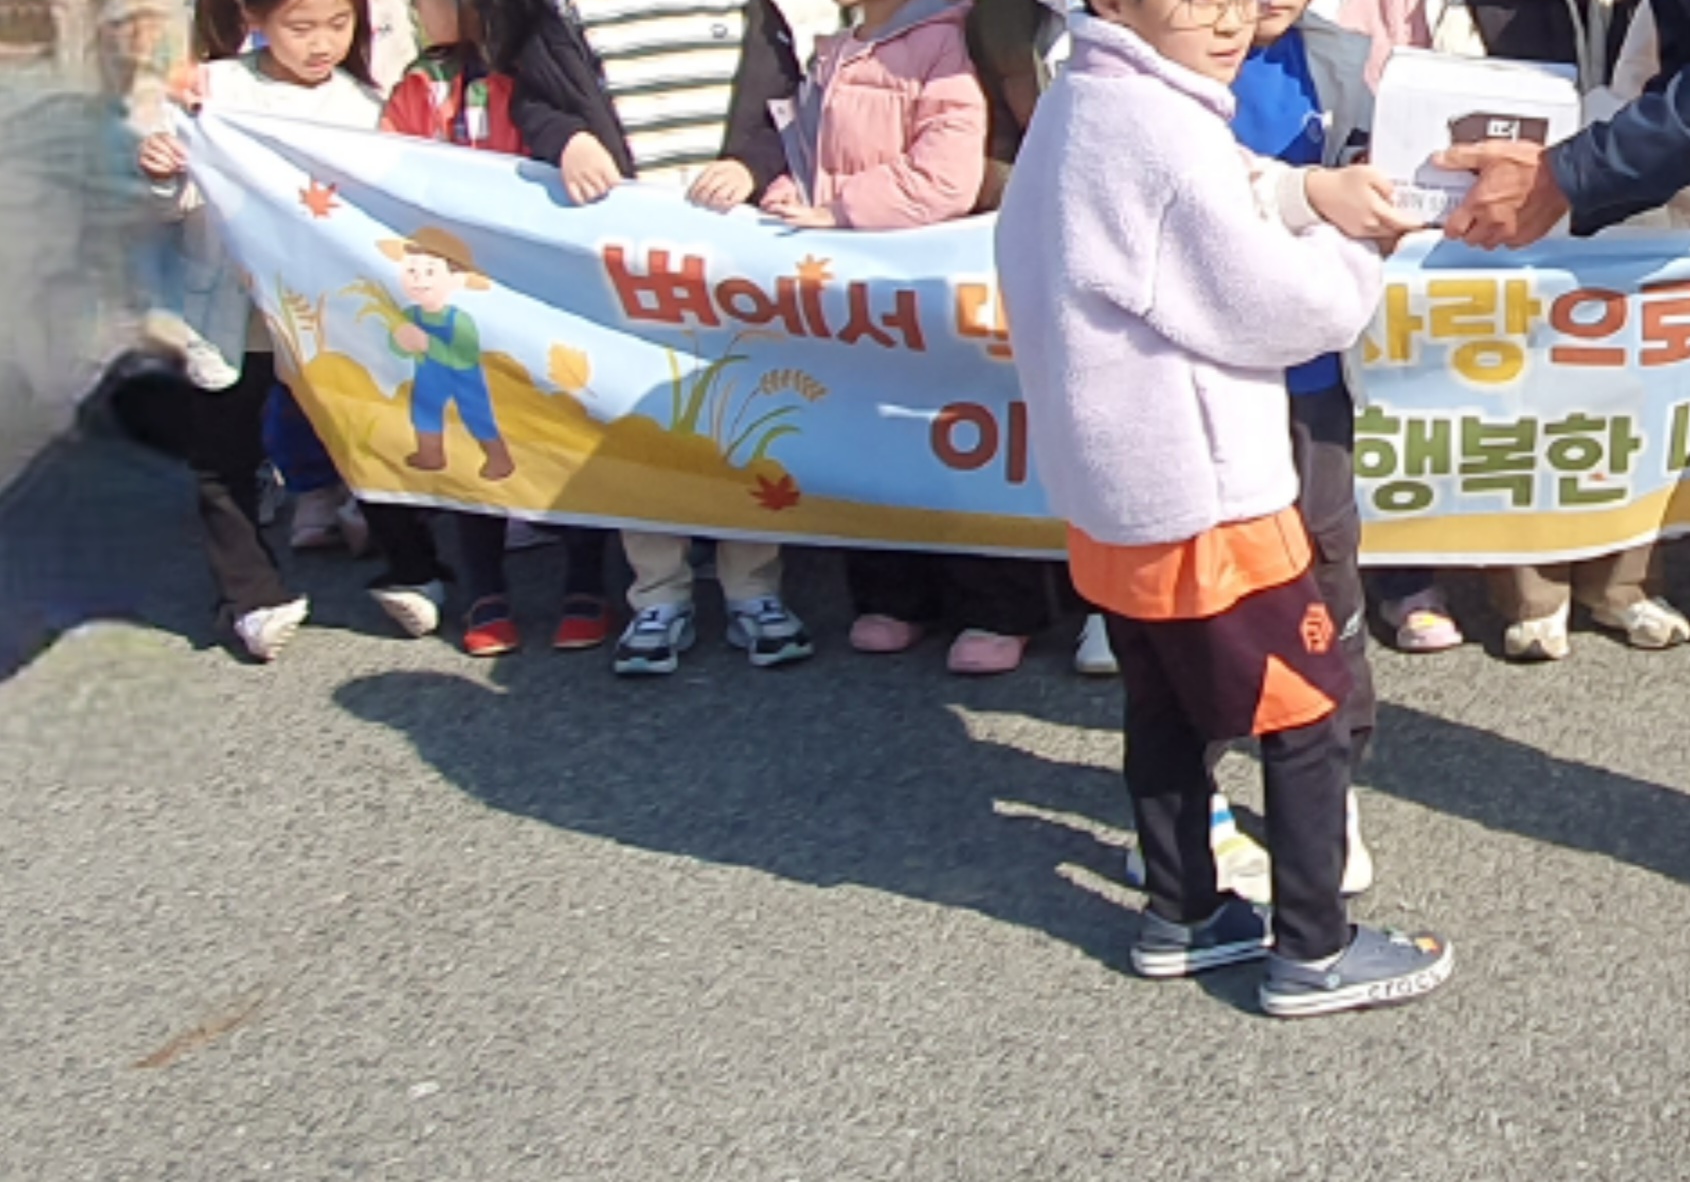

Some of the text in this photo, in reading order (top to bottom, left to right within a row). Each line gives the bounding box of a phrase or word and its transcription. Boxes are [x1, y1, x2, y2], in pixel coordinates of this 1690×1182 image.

[603, 245, 926, 352] 벼에서
[1353, 404, 1642, 512] 행복한
[1367, 968, 1442, 1000] crocs
